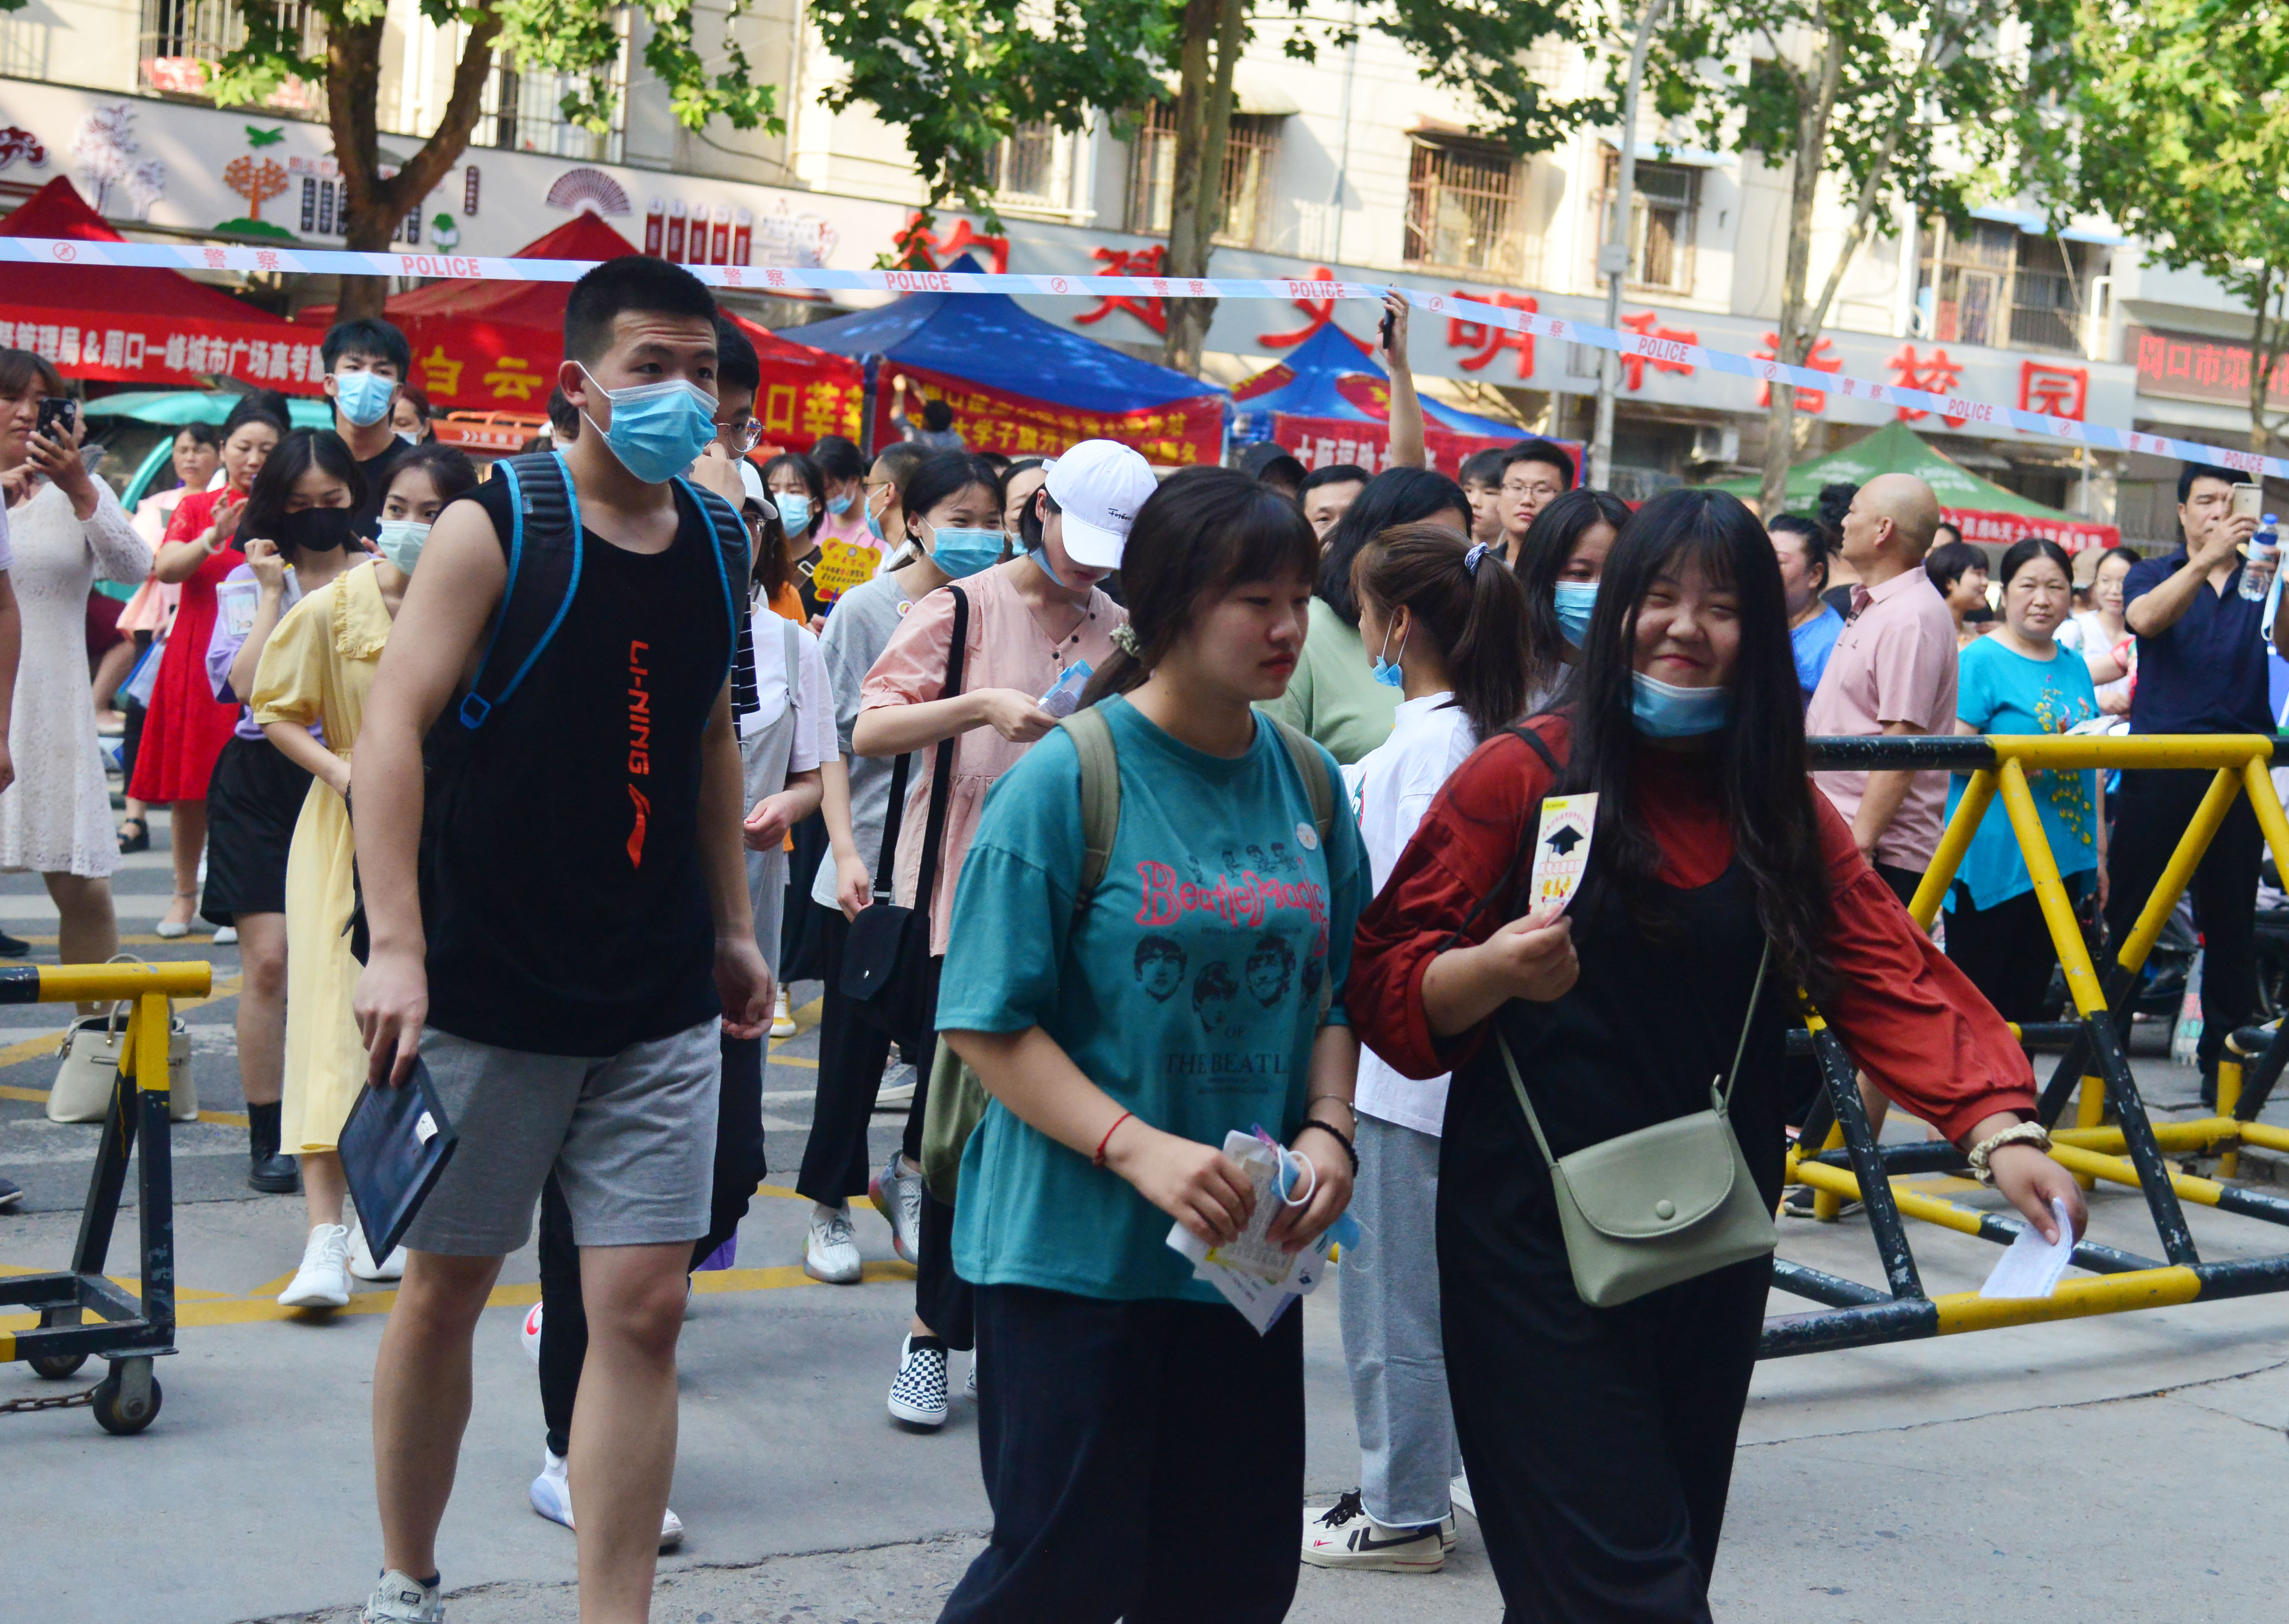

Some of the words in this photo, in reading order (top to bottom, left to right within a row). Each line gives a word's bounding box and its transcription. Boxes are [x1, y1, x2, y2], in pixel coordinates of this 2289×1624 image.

[402, 255, 481, 277] POLICE
[885, 272, 952, 290] POLICE
[1289, 281, 1346, 299] POLICE
[1638, 337, 1690, 362] POLICE
[2137, 334, 2289, 396] 周口市第
[1948, 399, 1994, 421] POLICE
[2223, 451, 2265, 473] POLICE
[628, 639, 649, 775] LI-NING
[1165, 1052, 1207, 1075] THE
